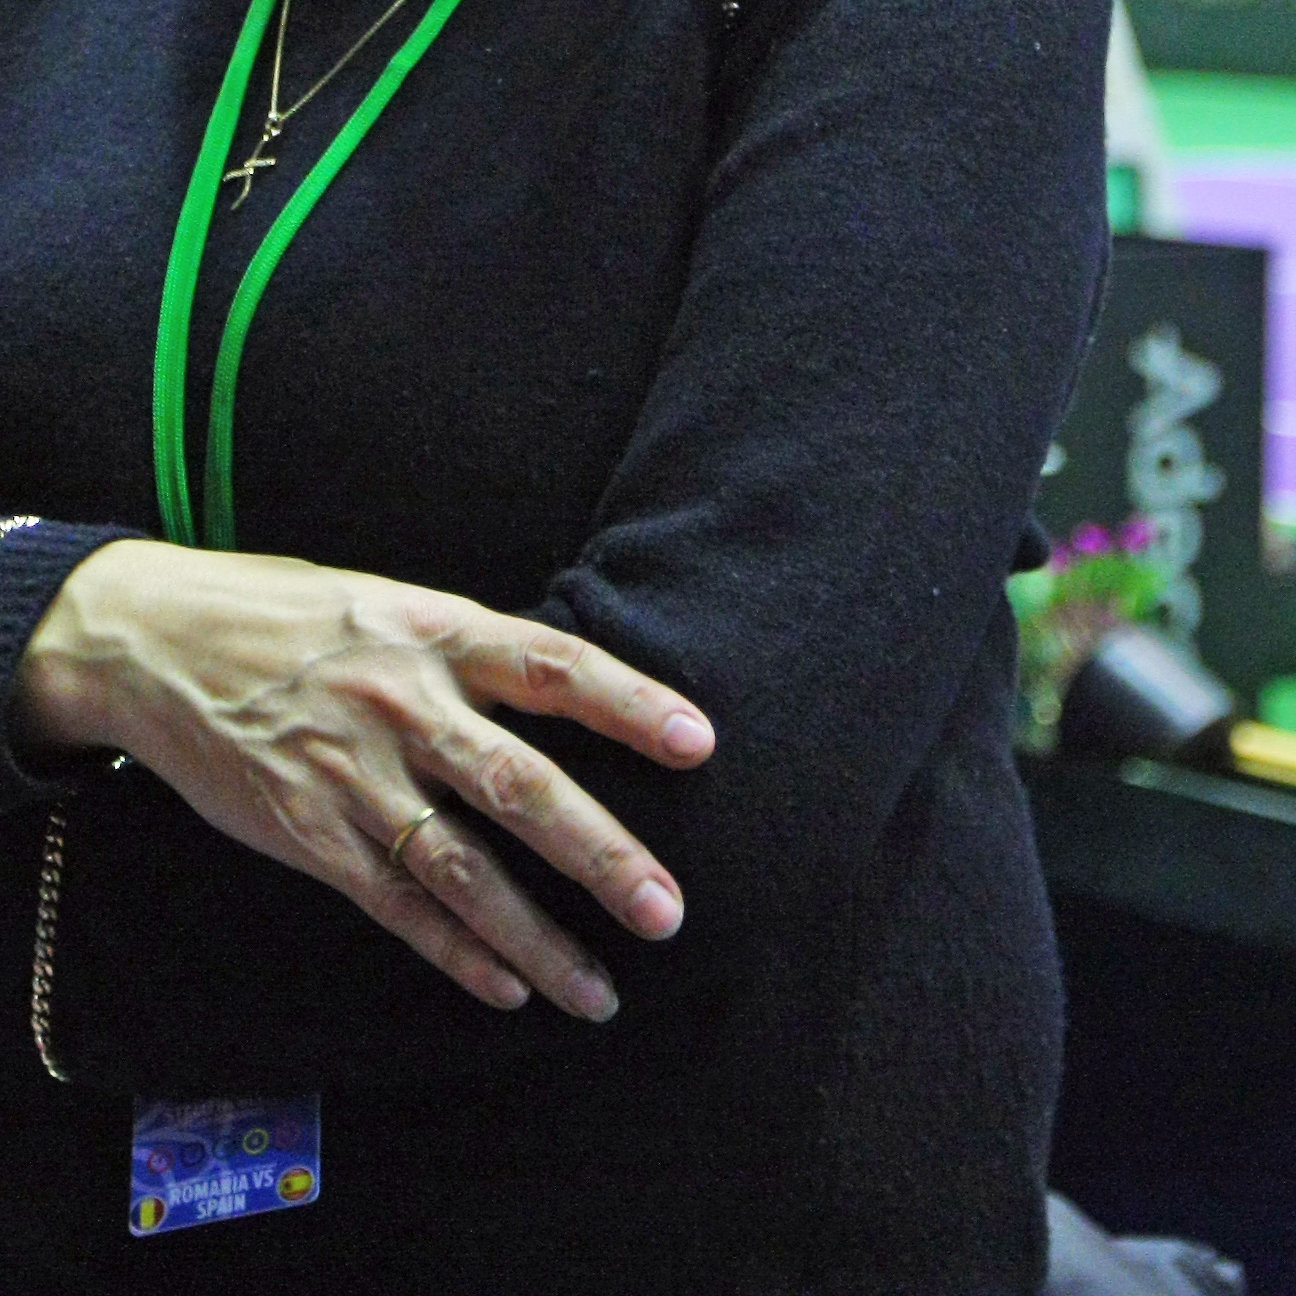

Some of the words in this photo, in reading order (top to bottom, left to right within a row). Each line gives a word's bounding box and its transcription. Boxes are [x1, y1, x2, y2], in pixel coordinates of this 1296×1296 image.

[169, 1174, 248, 1205] ROMANIA
[252, 1169, 274, 1189] VS
[197, 1193, 246, 1219] SPAIN
